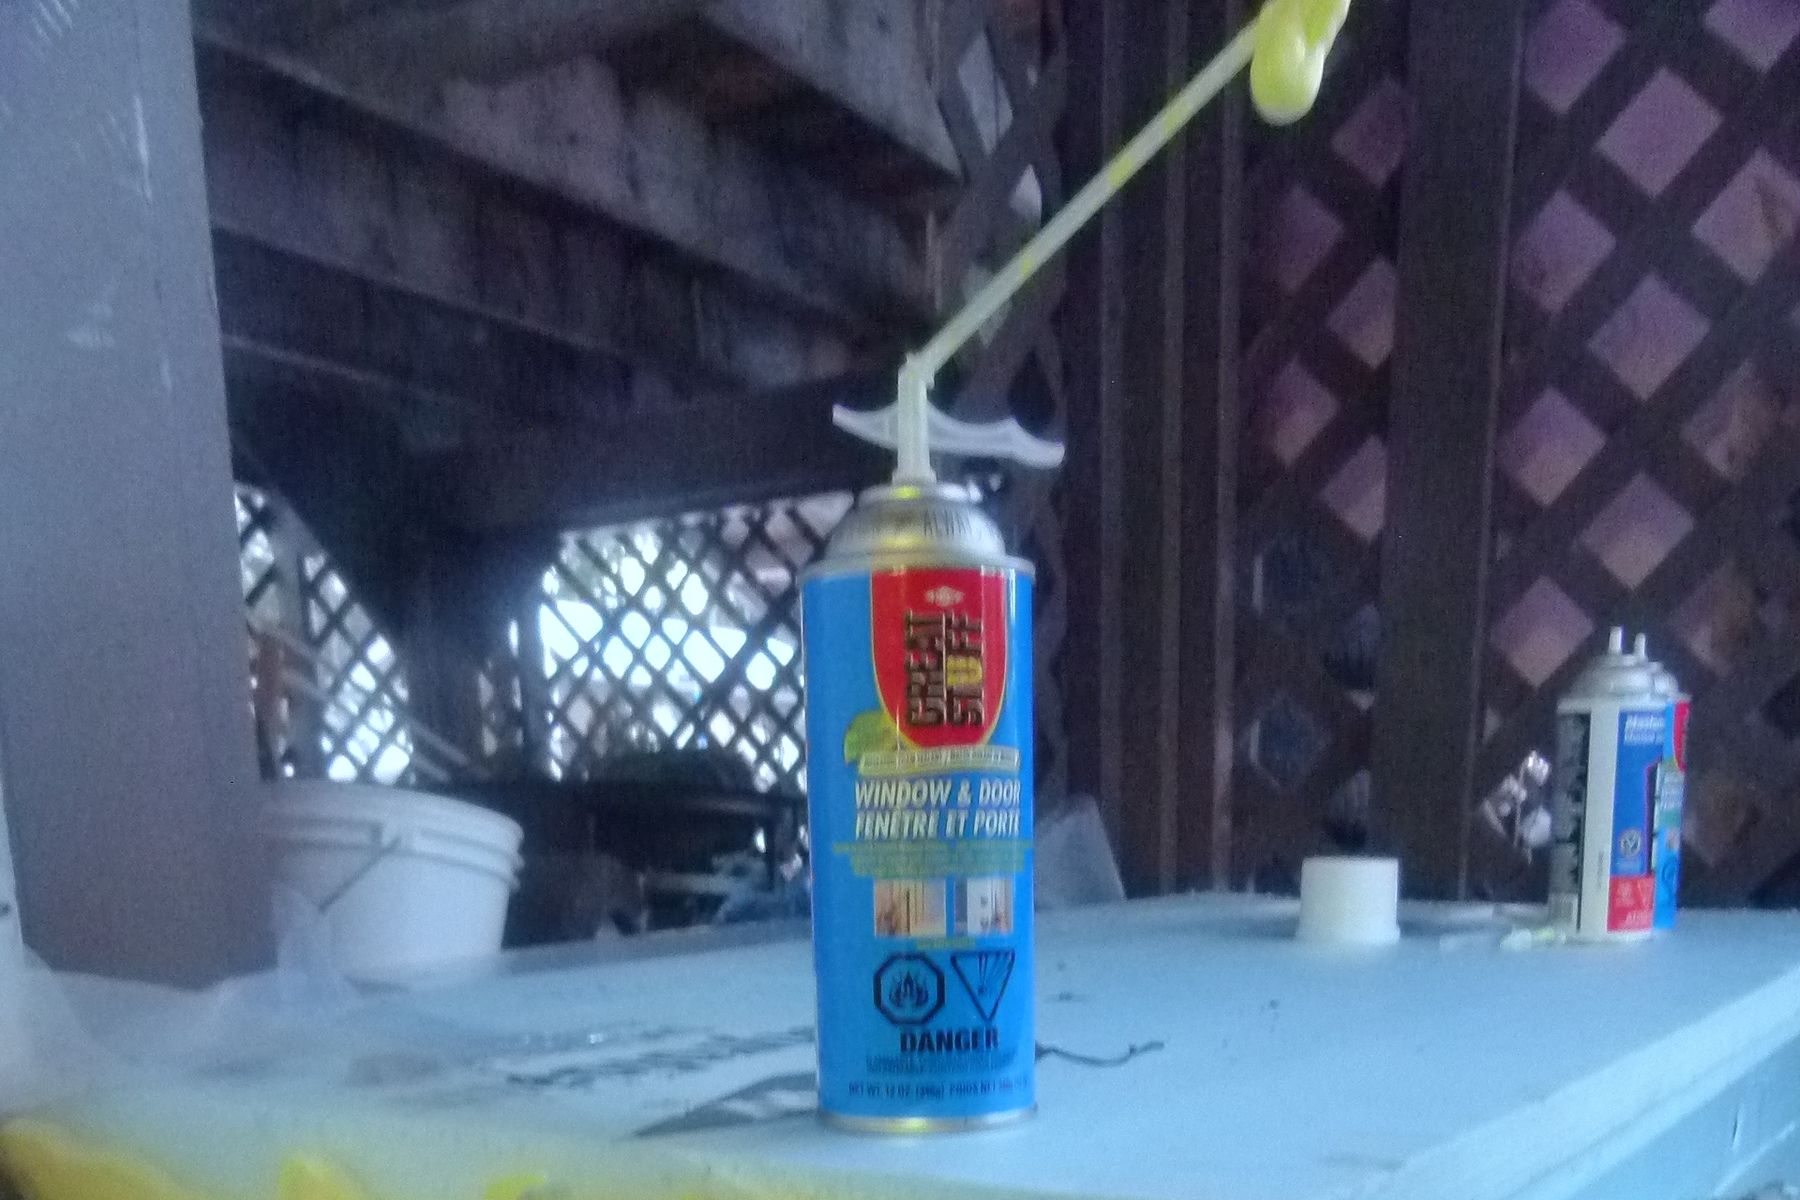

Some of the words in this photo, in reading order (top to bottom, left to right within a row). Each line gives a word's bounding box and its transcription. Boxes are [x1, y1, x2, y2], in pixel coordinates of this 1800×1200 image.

[855, 778, 951, 809] WINDOW
[958, 780, 971, 808] &
[979, 778, 1021, 808] DOOR
[900, 1029, 998, 1053] DANGER
